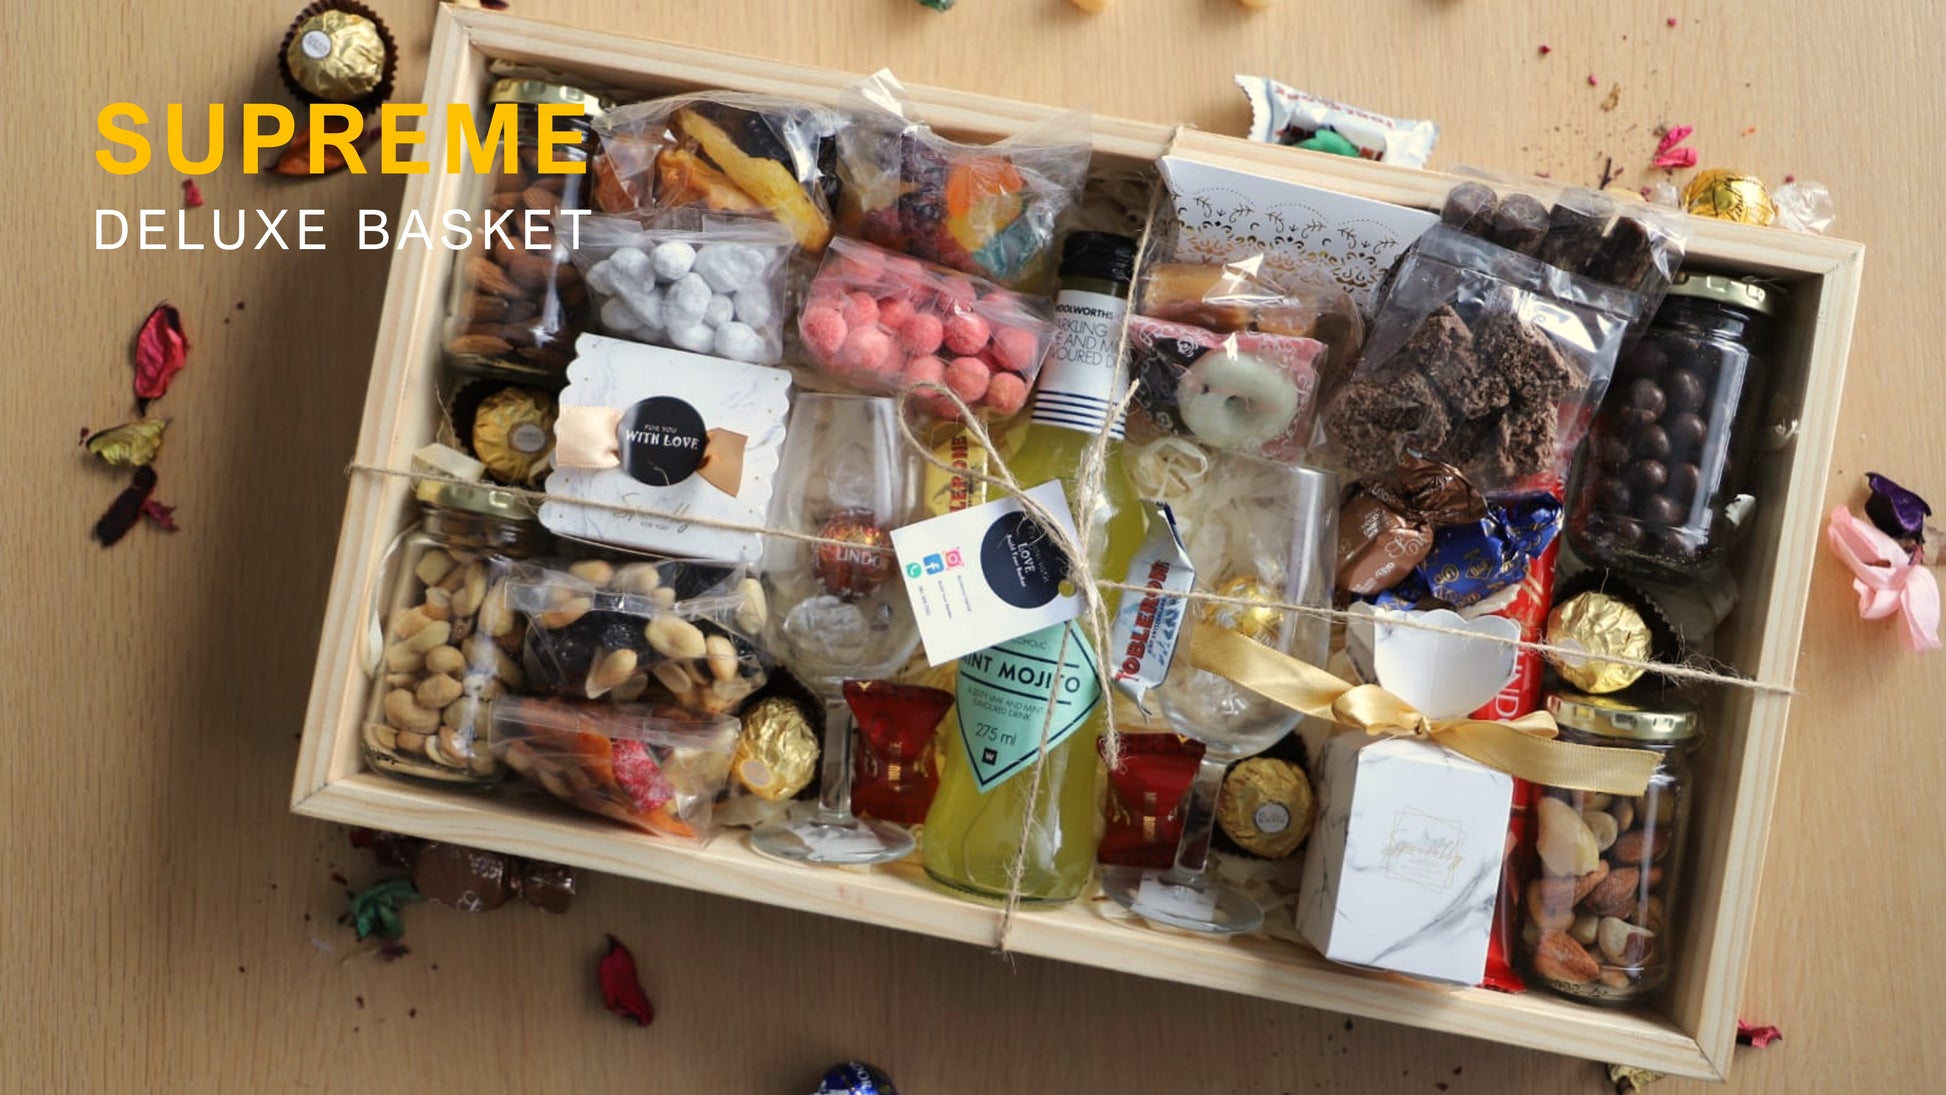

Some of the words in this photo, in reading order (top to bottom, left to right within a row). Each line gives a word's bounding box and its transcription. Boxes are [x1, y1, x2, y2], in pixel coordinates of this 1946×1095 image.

[1064, 334, 1097, 350] AND
[1052, 346, 1102, 366] OURED
[625, 429, 660, 445] WITH
[663, 434, 700, 450] LOVE
[949, 435, 968, 512] LERONE
[1017, 542, 1036, 574] LOVE
[1005, 699, 1023, 710] AND
[1024, 703, 1044, 714] MINT
[1008, 709, 1032, 720] DRINK
[975, 722, 998, 741] 275
[1000, 733, 1017, 746] ml
